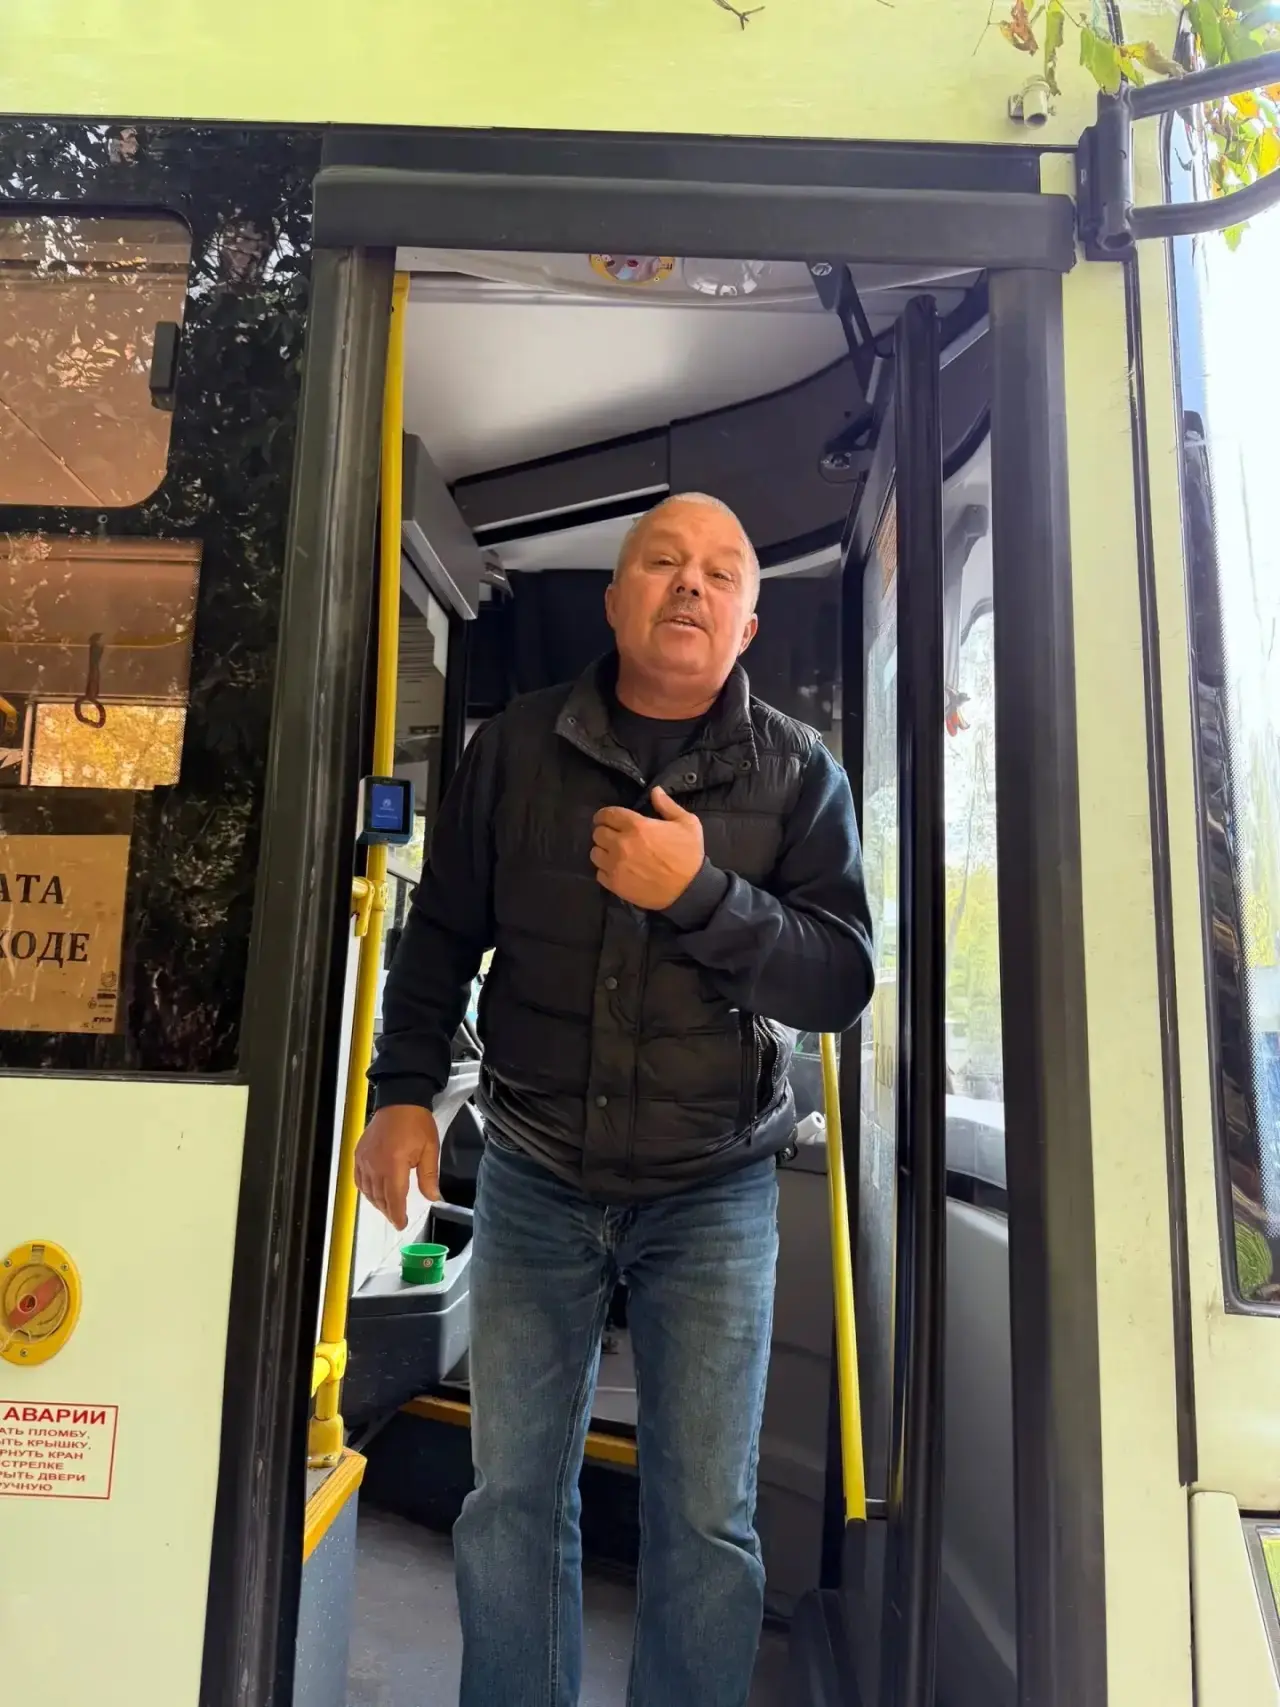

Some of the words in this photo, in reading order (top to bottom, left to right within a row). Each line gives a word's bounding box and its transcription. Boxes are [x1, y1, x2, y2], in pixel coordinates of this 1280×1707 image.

[3, 1406, 106, 1425] АВАРИИ
[28, 1428, 90, 1439] ПЛОМБУ,
[27, 1439, 91, 1450] КРЫШКУ,
[48, 1451, 83, 1459] КРАН
[1, 1460, 64, 1470] СТРЕЛКЕ
[37, 1472, 85, 1482] ДВЕРИ
[0, 1482, 53, 1491] УЧНУЮ
